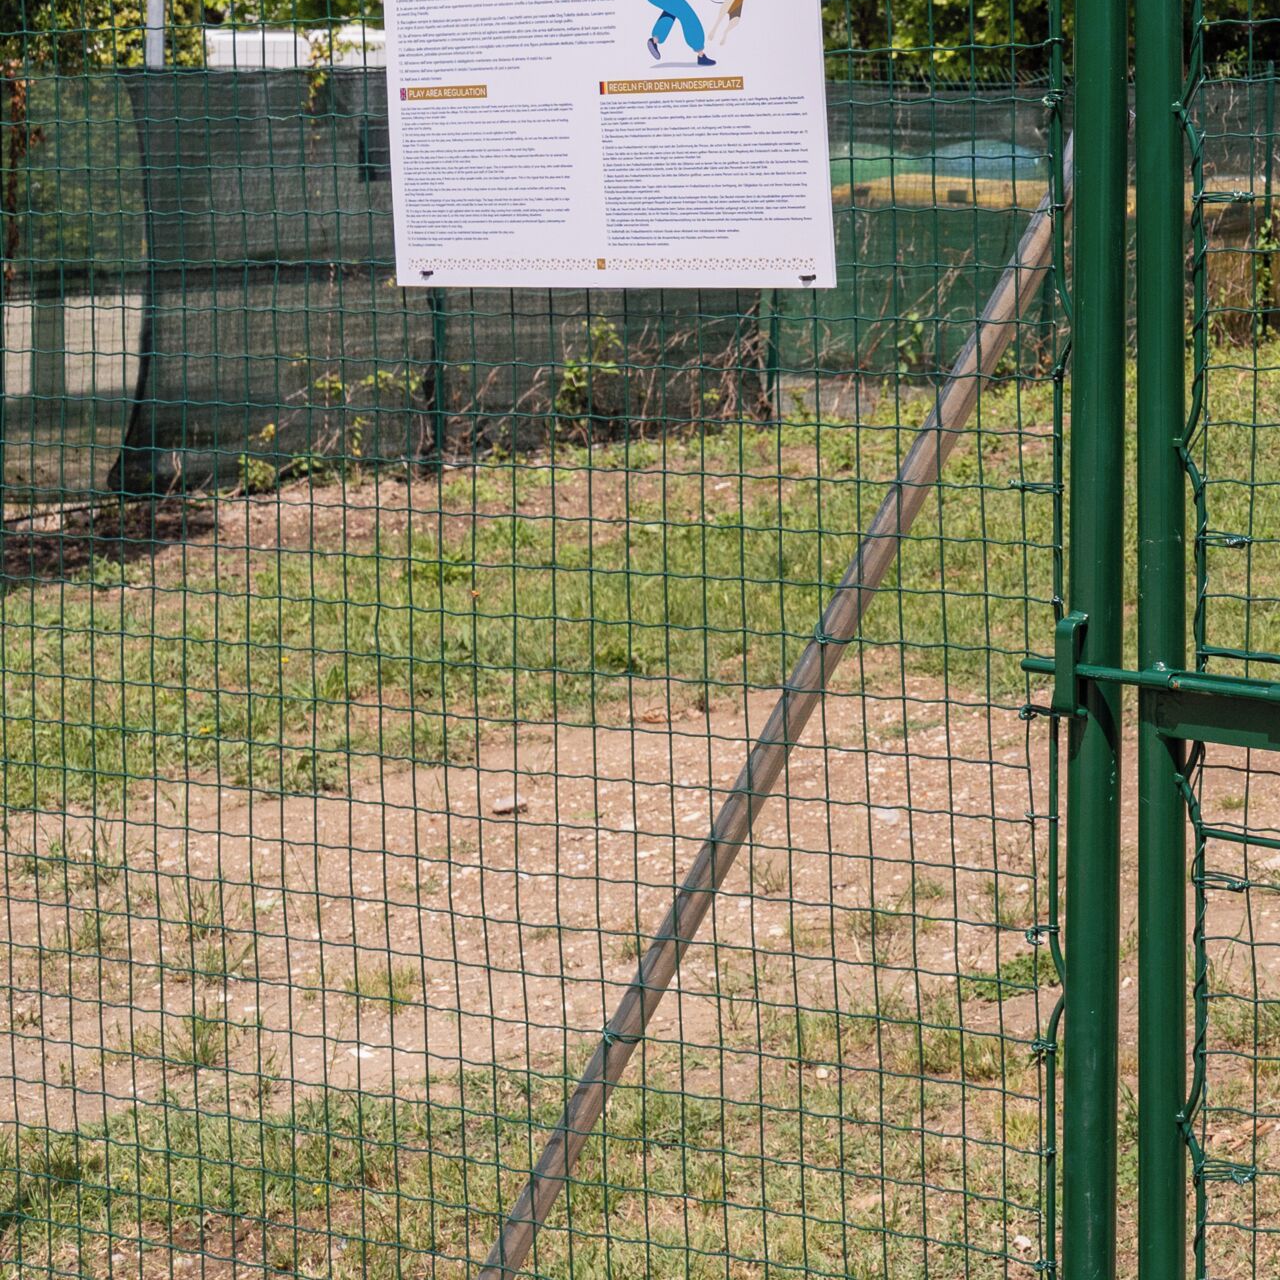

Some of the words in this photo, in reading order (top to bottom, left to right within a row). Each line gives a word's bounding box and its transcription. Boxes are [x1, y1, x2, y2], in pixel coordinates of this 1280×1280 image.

[608, 83, 637, 92] REGELN
[638, 80, 653, 91] FÜR
[654, 81, 670, 90] DEN
[671, 79, 742, 90] HUNDESPIELPLATZ
[408, 90, 424, 98] PLAY
[425, 89, 443, 97] AREA
[443, 87, 486, 97] REGULATION
